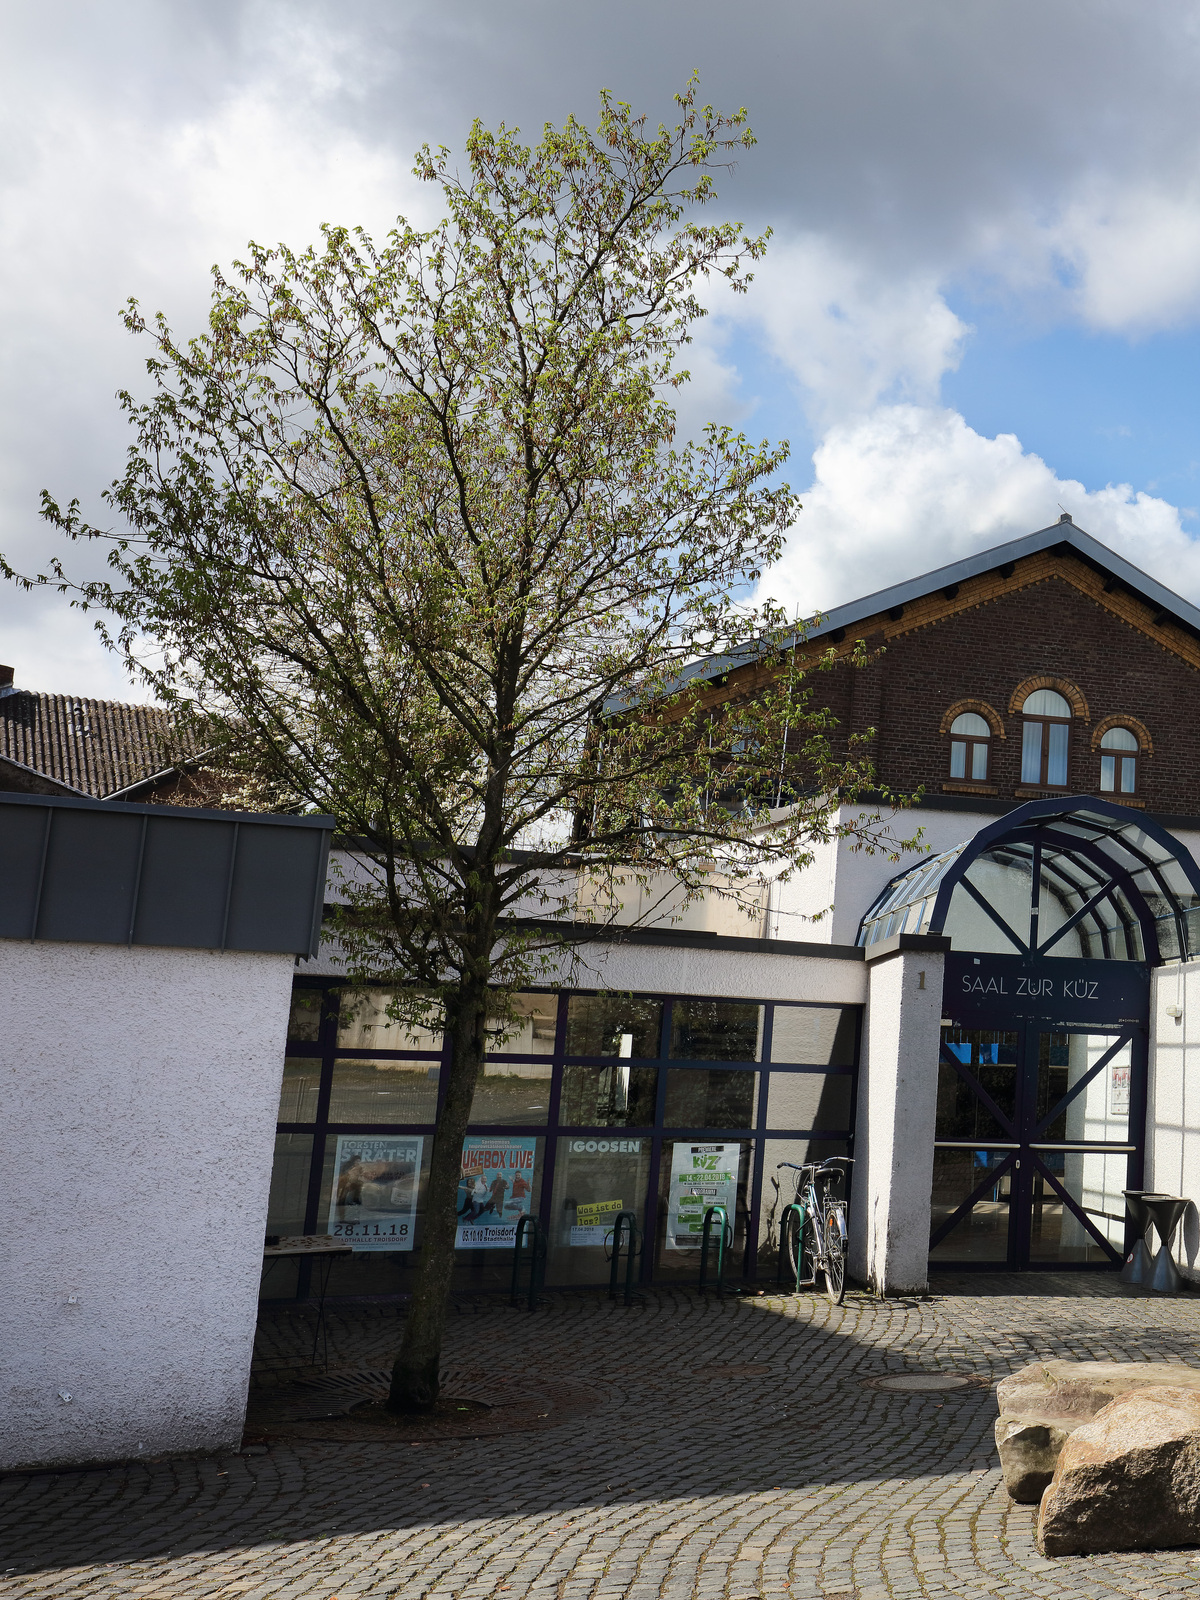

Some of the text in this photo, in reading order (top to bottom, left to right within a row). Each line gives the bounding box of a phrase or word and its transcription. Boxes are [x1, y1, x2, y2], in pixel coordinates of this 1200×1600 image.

[916, 970, 927, 990] 1
[962, 974, 1099, 1000] SAAL ZUR KÜZ
[343, 1141, 388, 1149] TORSTEN
[573, 1140, 641, 1153] GOOSEN
[340, 1148, 417, 1162] STRÄTER
[461, 1150, 534, 1169] UKEBOX LIVE
[692, 1154, 719, 1170] KÜZ
[696, 1173, 726, 1181] 22.04.2018
[577, 1201, 622, 1215] Was ist da
[578, 1216, 599, 1226] los?
[333, 1223, 409, 1237] 28.11.18
[462, 1229, 484, 1242] 05.10.18
